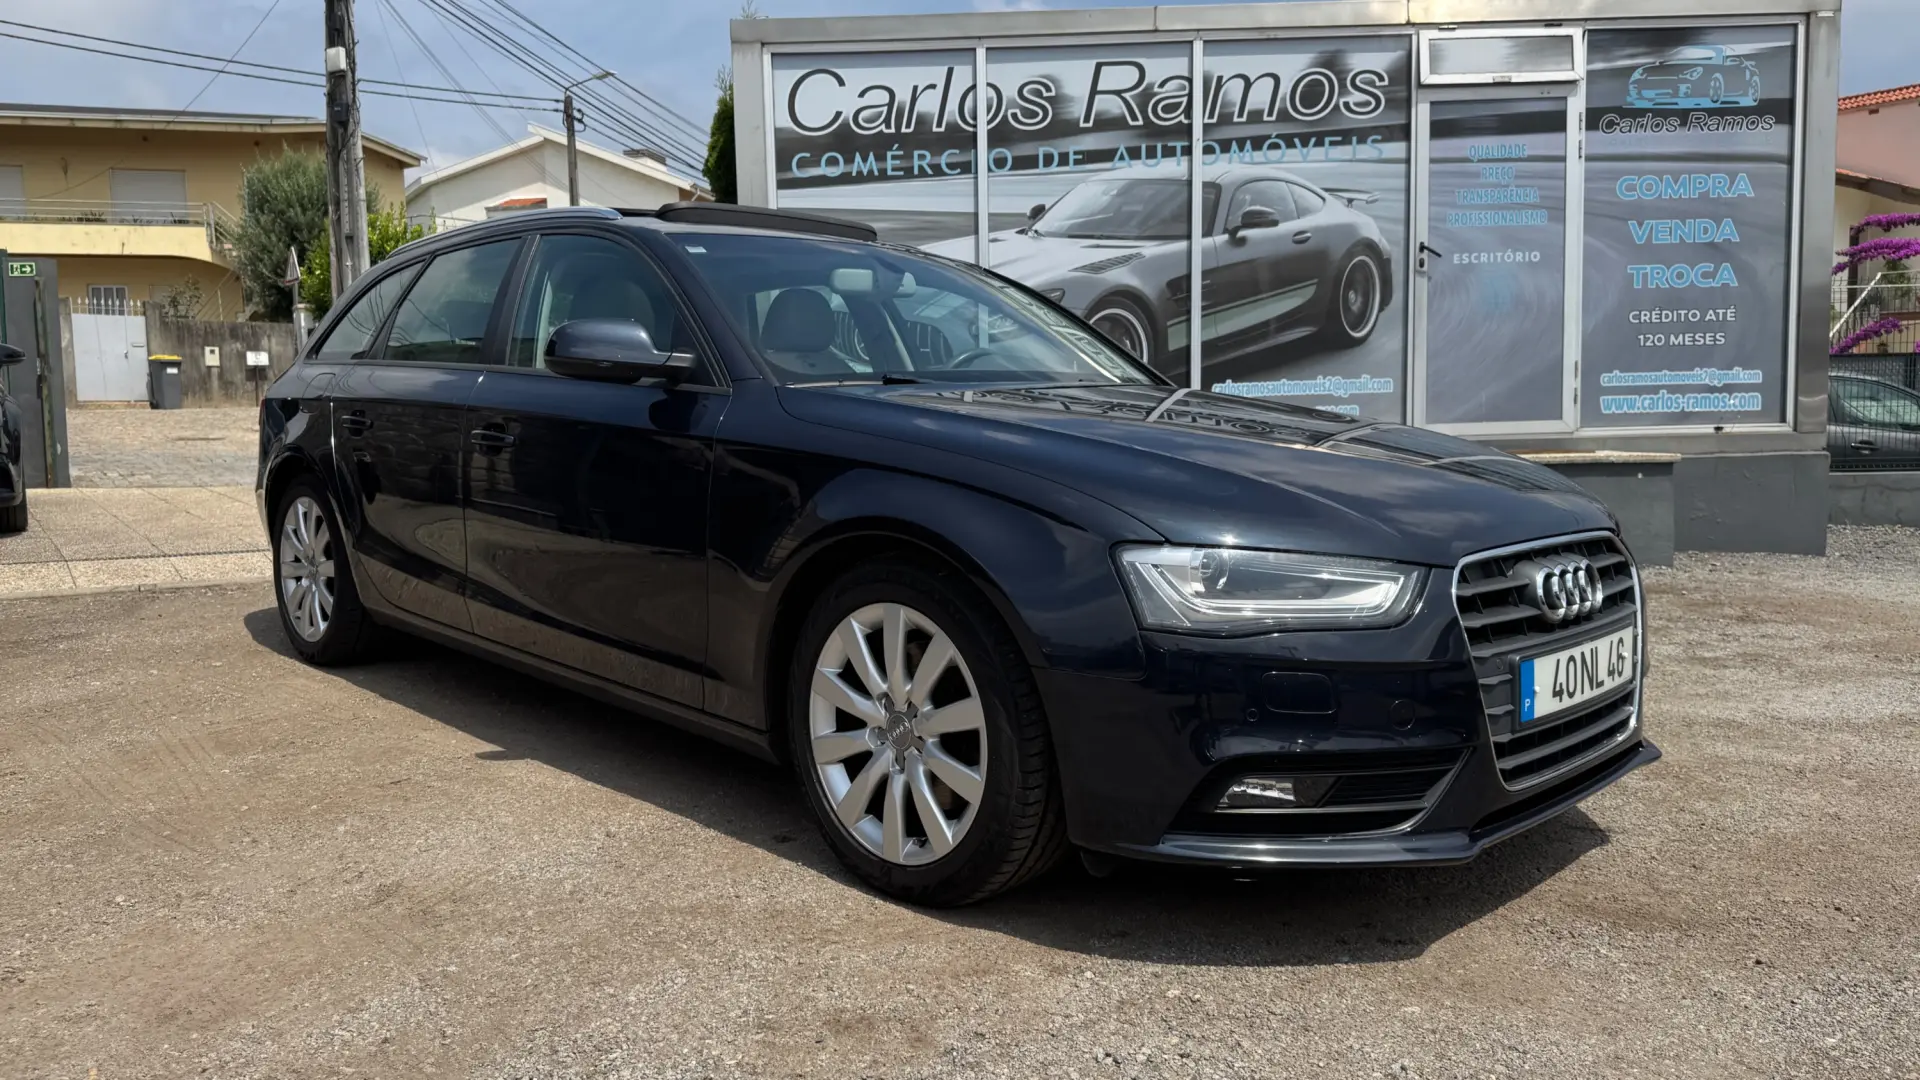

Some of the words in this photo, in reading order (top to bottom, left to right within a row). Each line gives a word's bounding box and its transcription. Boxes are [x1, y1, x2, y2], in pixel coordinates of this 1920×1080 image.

[787, 66, 1056, 136] Carlos
[1079, 60, 1389, 128] Ramos
[1599, 113, 1680, 135] Carlos
[1686, 111, 1776, 133] Ramos
[791, 144, 1013, 177] COMÉRCIO
[1038, 145, 1085, 172] DE
[1111, 132, 1384, 169] AUTOMÓVEIS
[1468, 144, 1528, 162] QUALIDADE
[1481, 166, 1515, 184] PREÇO
[1616, 173, 1755, 200] COMPRA
[1447, 209, 1548, 228] PROFISSIONALISMO
[1628, 218, 1740, 244] VENDA
[1453, 249, 1541, 264] ESCRITÓRIO
[1627, 263, 1738, 289] TROCA
[1628, 307, 1701, 323] CRÉDITO
[1704, 305, 1737, 322] ATÉ
[1637, 333, 1666, 347] 120
[1669, 332, 1726, 346] MESES
[1600, 390, 1762, 413] www.carlos-ramos.com
[1524, 698, 1531, 712] P
